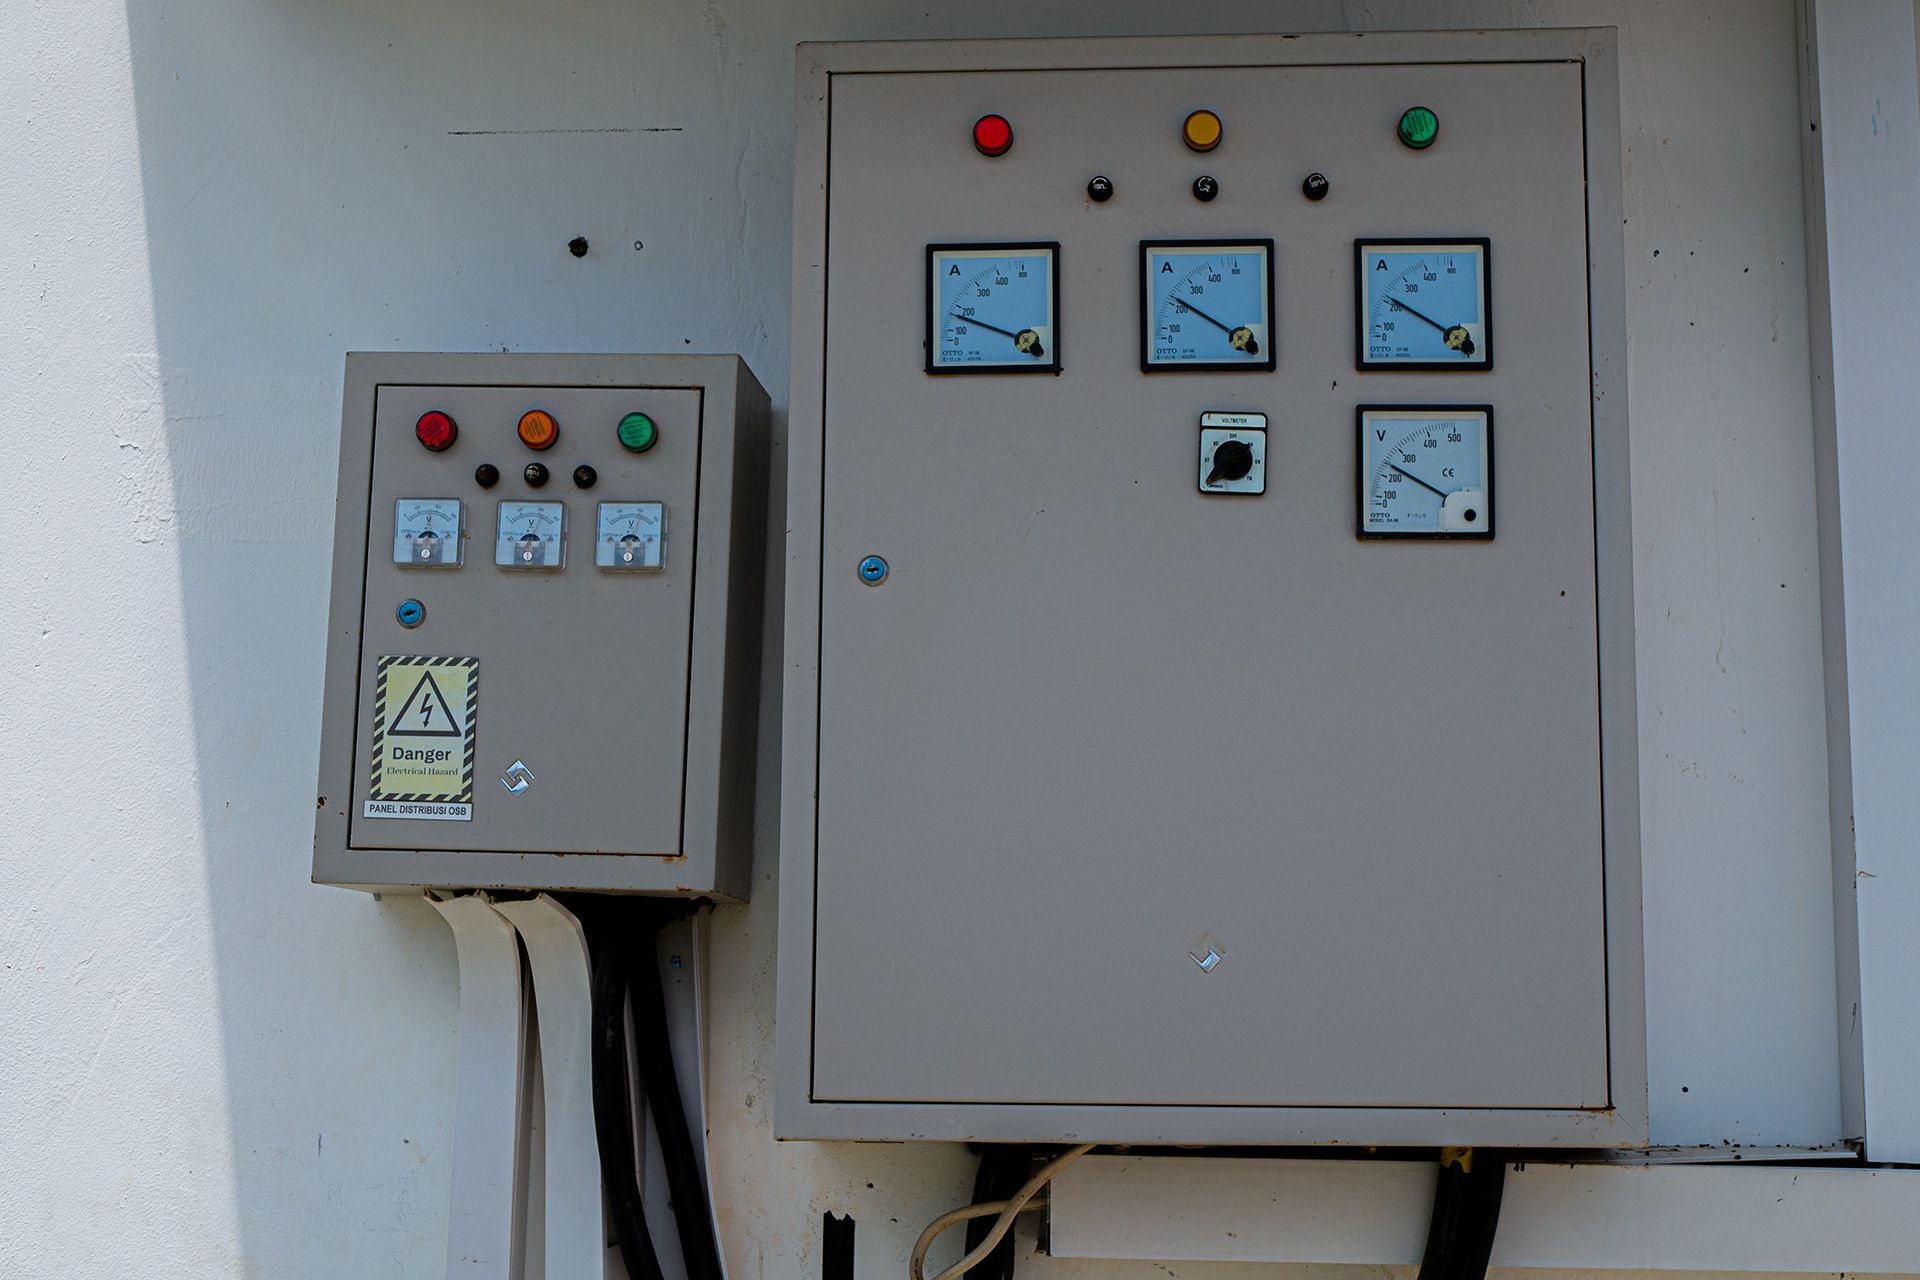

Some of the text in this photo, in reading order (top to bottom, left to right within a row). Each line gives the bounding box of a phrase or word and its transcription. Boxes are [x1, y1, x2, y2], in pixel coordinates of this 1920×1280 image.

[1161, 262, 1173, 273] A
[1376, 260, 1388, 271] A
[949, 264, 960, 276] A
[996, 277, 1008, 285] 400
[1209, 274, 1221, 282] 400
[1424, 273, 1436, 281] 400
[1190, 286, 1203, 294] 300
[1405, 284, 1418, 293] 300
[978, 289, 990, 297] 300
[962, 308, 975, 316] 200
[1176, 305, 1188, 313] 200
[1169, 325, 1180, 333] 100
[1383, 322, 1394, 331] 100
[955, 327, 967, 335] 100
[1168, 335, 1172, 343] 0
[1382, 333, 1386, 341] 0
[954, 338, 958, 346] 0
[1376, 430, 1386, 441] V
[1448, 434, 1461, 442] 500
[1424, 440, 1437, 448] 400
[1403, 454, 1415, 463] 300
[1442, 468, 1454, 477] CE
[1389, 474, 1402, 482] 200
[1384, 491, 1396, 499] 100
[1383, 500, 1387, 508] 0
[393, 747, 451, 763] Danger
[387, 767, 458, 776] Electrical Hazard
[370, 804, 466, 815] PANEL DISTRIBUSI OSB
